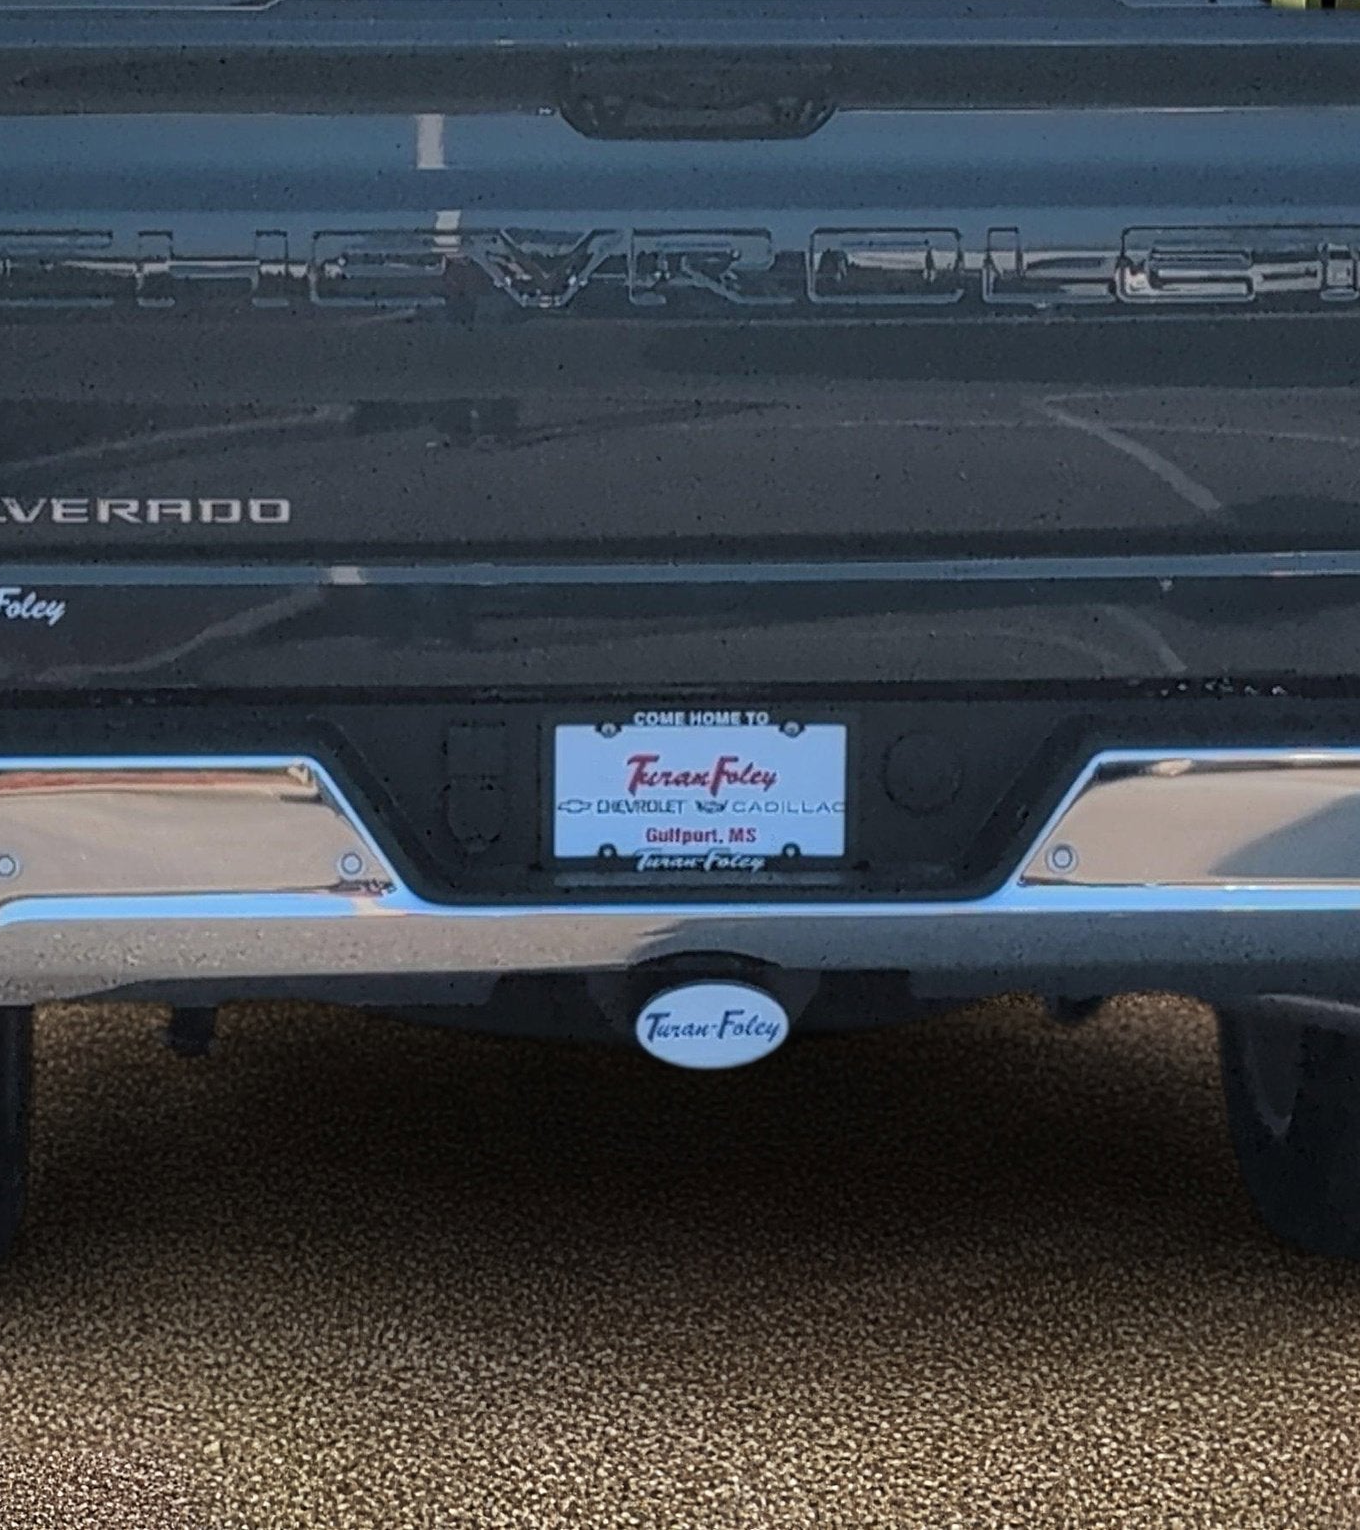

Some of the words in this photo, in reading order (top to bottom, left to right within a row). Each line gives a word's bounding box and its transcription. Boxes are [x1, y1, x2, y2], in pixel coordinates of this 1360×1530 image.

[633, 712, 685, 726] COME
[690, 712, 743, 726] HOME
[745, 712, 770, 726] TO
[597, 800, 686, 814] CHEVROLET
[728, 827, 757, 843] MS
[645, 1009, 780, 1043] Turan-Foley
